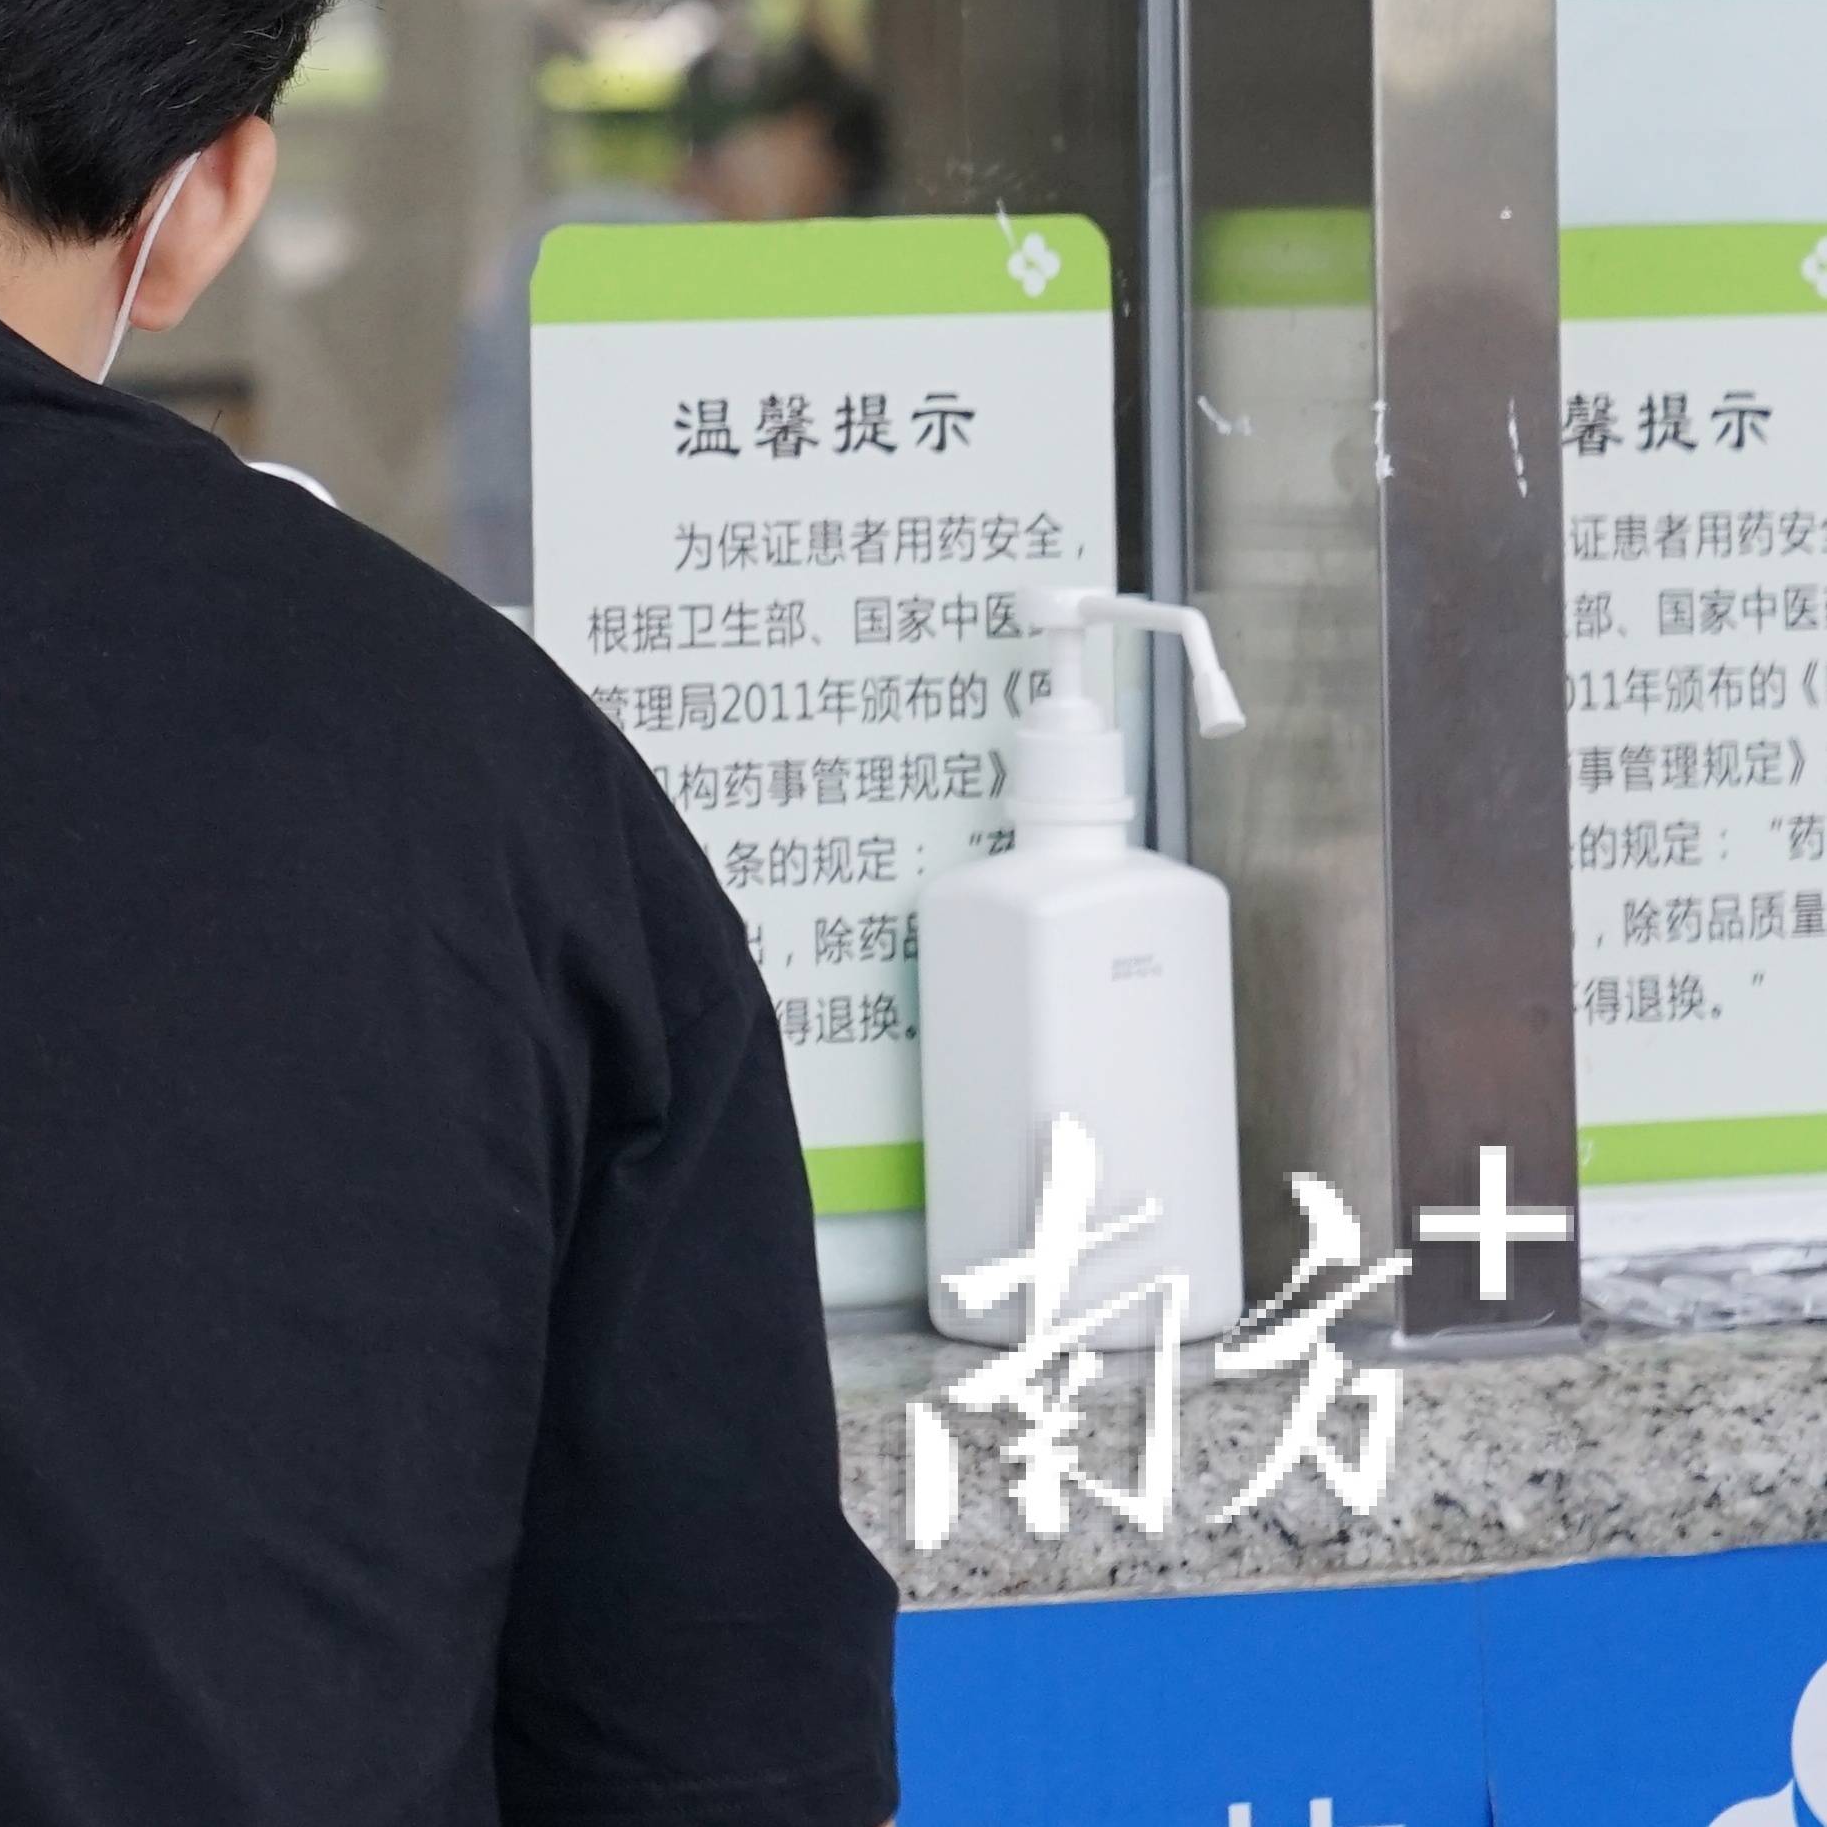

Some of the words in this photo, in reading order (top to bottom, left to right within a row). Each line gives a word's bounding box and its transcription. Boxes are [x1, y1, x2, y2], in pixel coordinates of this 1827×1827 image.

[674, 390, 977, 461] 温馨提示
[1570, 510, 1827, 561] 证患者用药安
[587, 589, 1045, 655] 根据卫生部、国家中医
[1565, 583, 1827, 640] 部、国家中医
[1568, 736, 1806, 794] 事管理规定》
